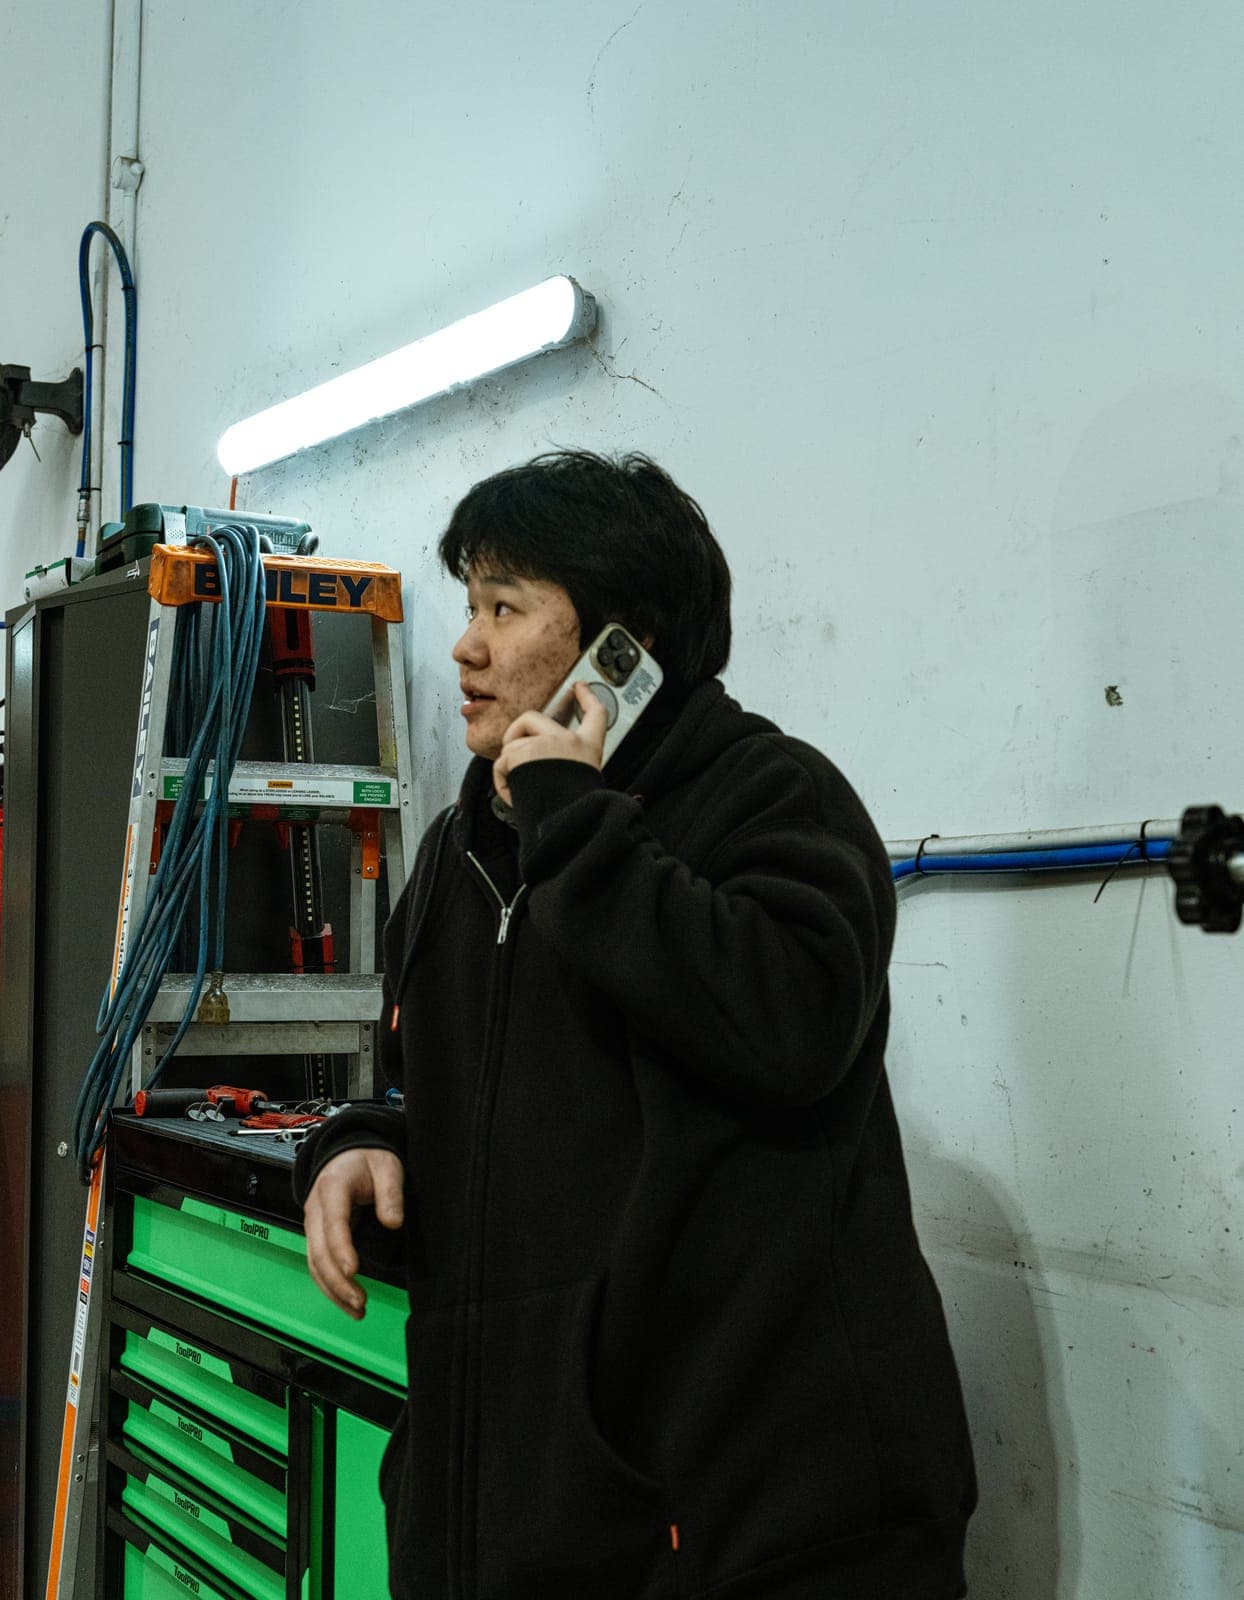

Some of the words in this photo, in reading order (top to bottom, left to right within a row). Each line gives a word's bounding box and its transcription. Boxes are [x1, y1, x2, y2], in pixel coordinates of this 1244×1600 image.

[194, 563, 373, 607] BILEY
[134, 627, 159, 788] BAILEY
[240, 1218, 270, 1240] ToolPRO
[176, 1342, 202, 1365] ToolPRO
[177, 1416, 203, 1441] ToolPRO
[174, 1491, 200, 1518] ToolPRO
[174, 1564, 200, 1594] ToolPRO
